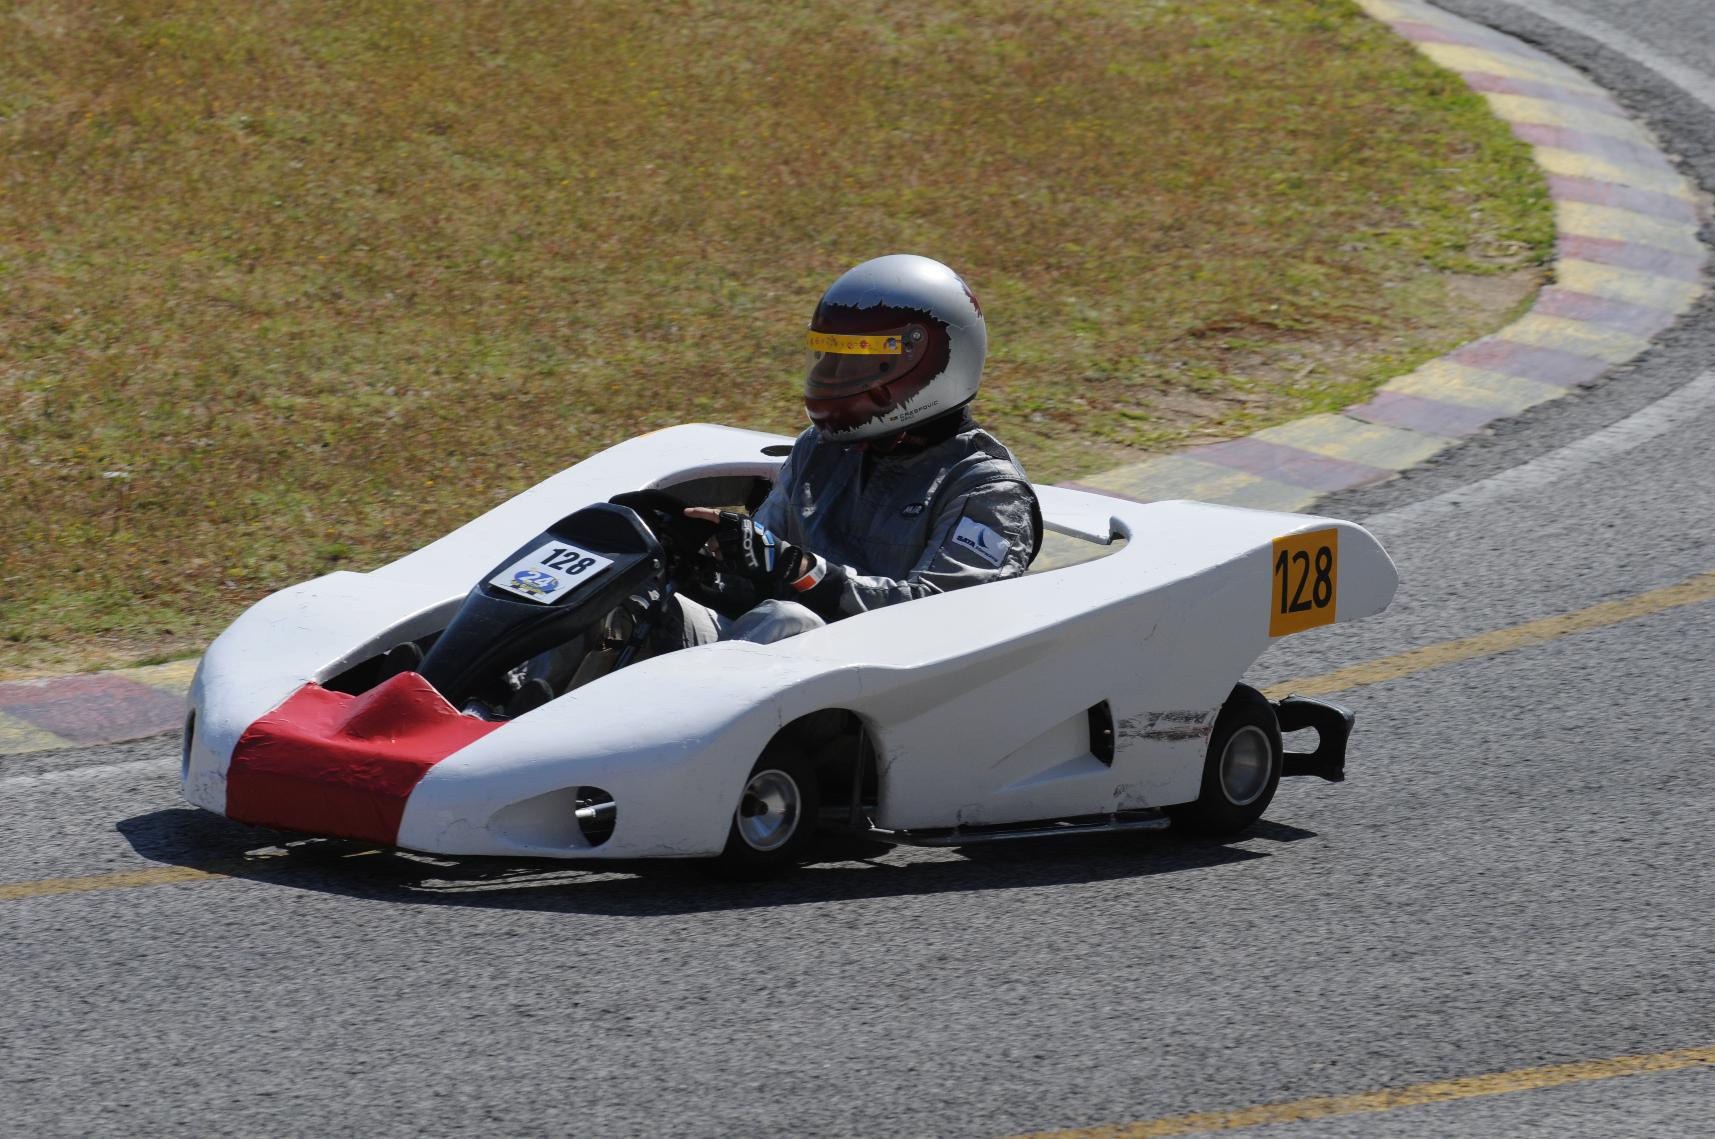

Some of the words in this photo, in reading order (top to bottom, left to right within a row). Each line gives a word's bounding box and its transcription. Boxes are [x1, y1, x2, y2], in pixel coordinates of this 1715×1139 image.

[741, 519, 758, 567] SCOTT
[956, 535, 976, 548] SATA
[540, 548, 596, 575] 128
[518, 571, 553, 587] 24
[1275, 546, 1332, 614] 128
